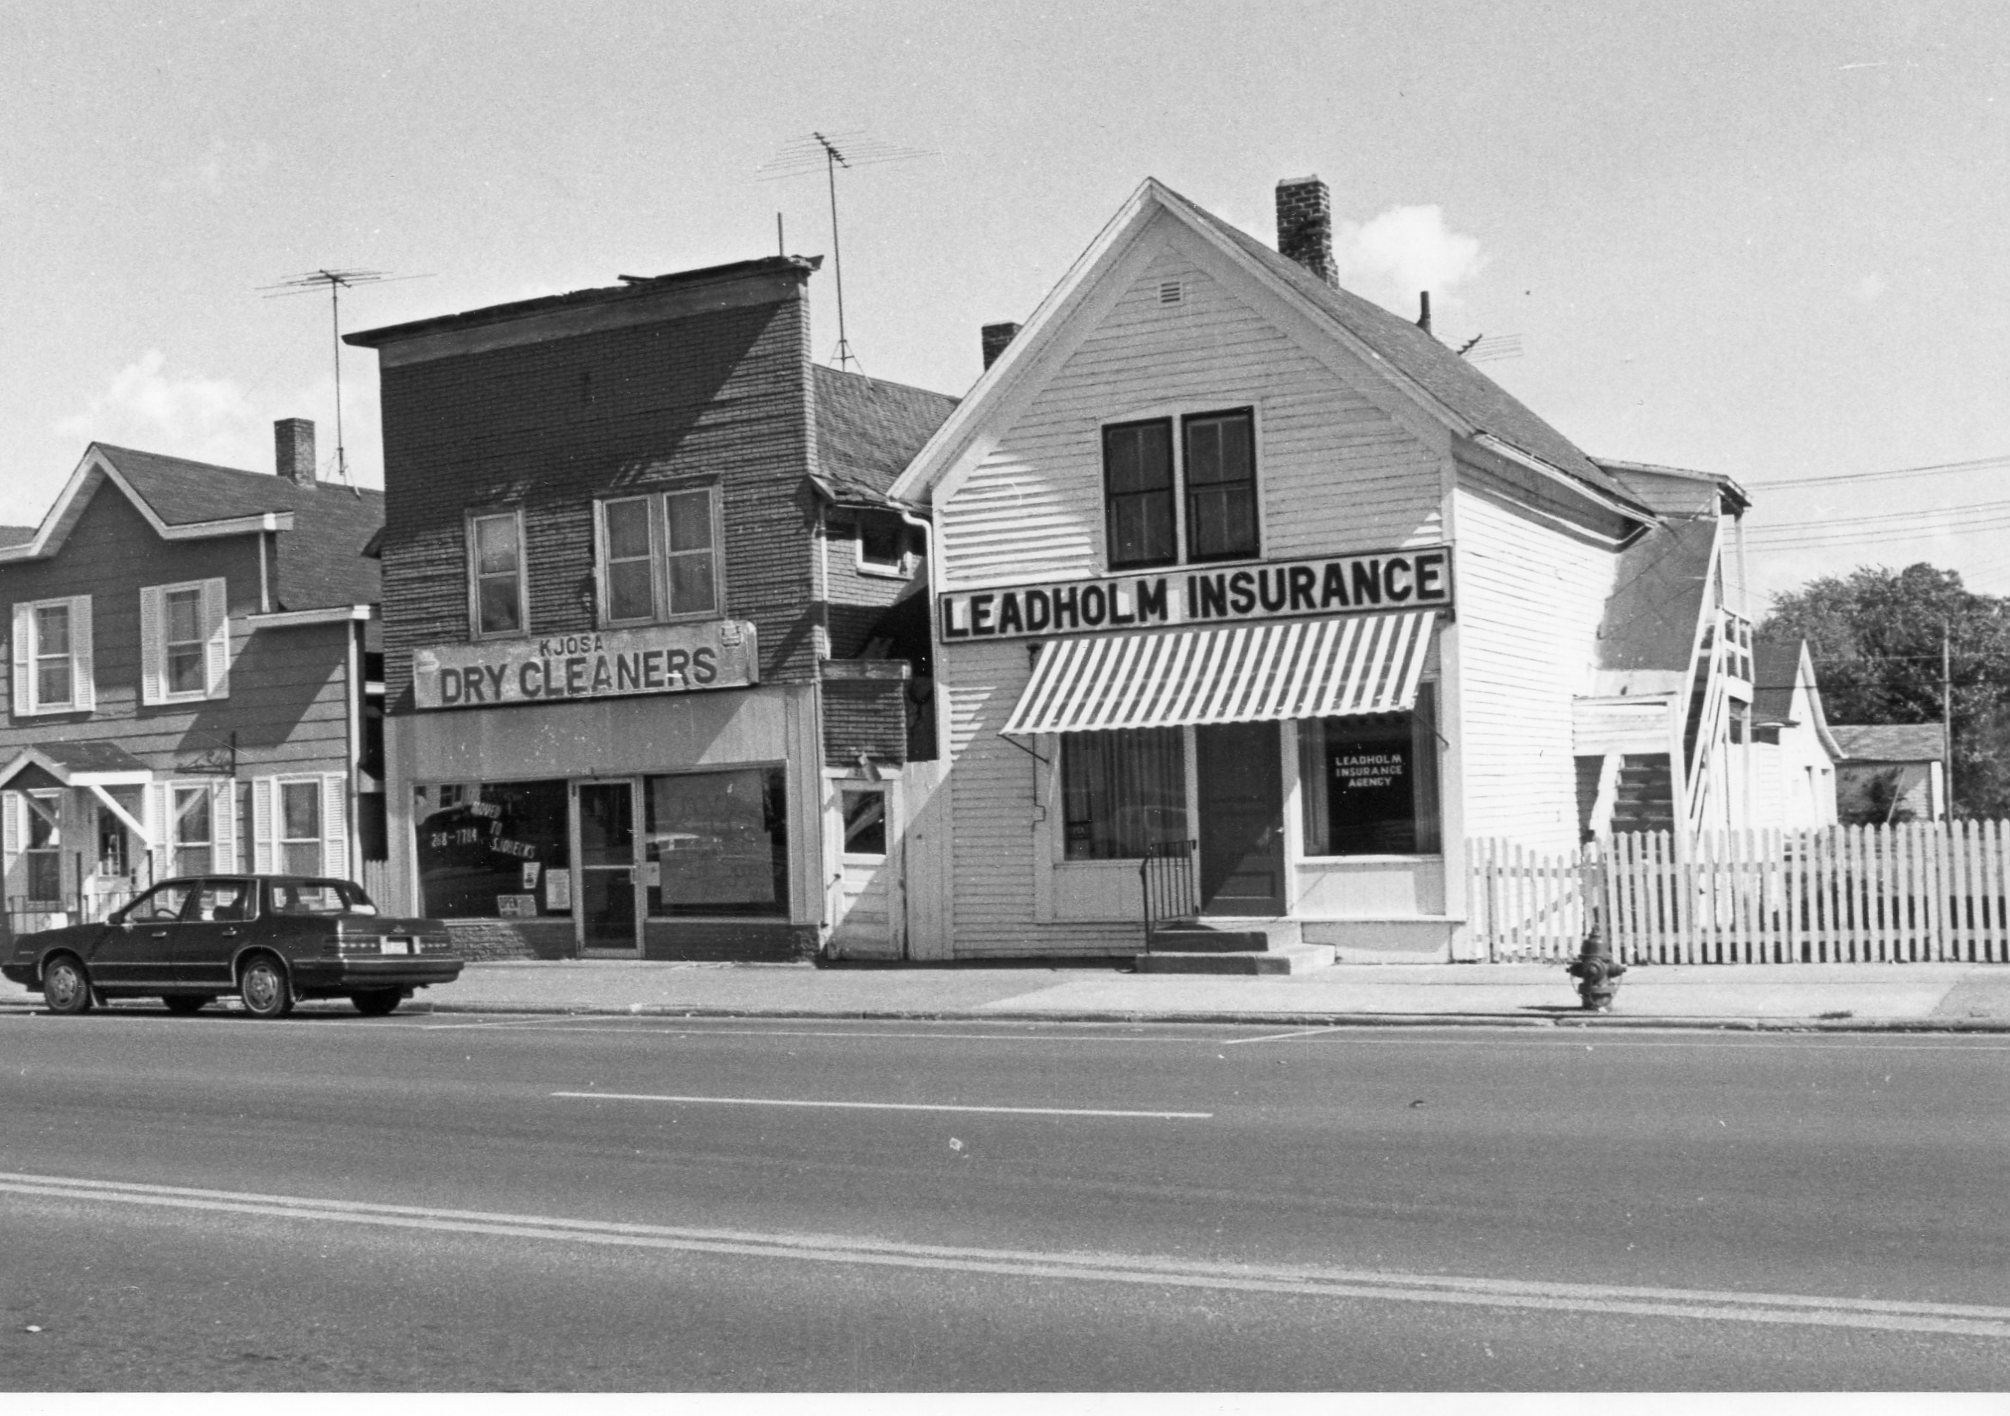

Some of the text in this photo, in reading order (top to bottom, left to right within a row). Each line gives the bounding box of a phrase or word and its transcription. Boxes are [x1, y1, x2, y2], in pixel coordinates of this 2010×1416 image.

[944, 554, 1446, 638] LEADHOLM INSURANCE
[540, 635, 604, 657] KJOSA
[441, 647, 718, 703] DRY CLEANERS
[1335, 754, 1402, 766] LEADHOLM
[1335, 765, 1402, 777] INSURANCE
[1348, 777, 1392, 787] AGENCY
